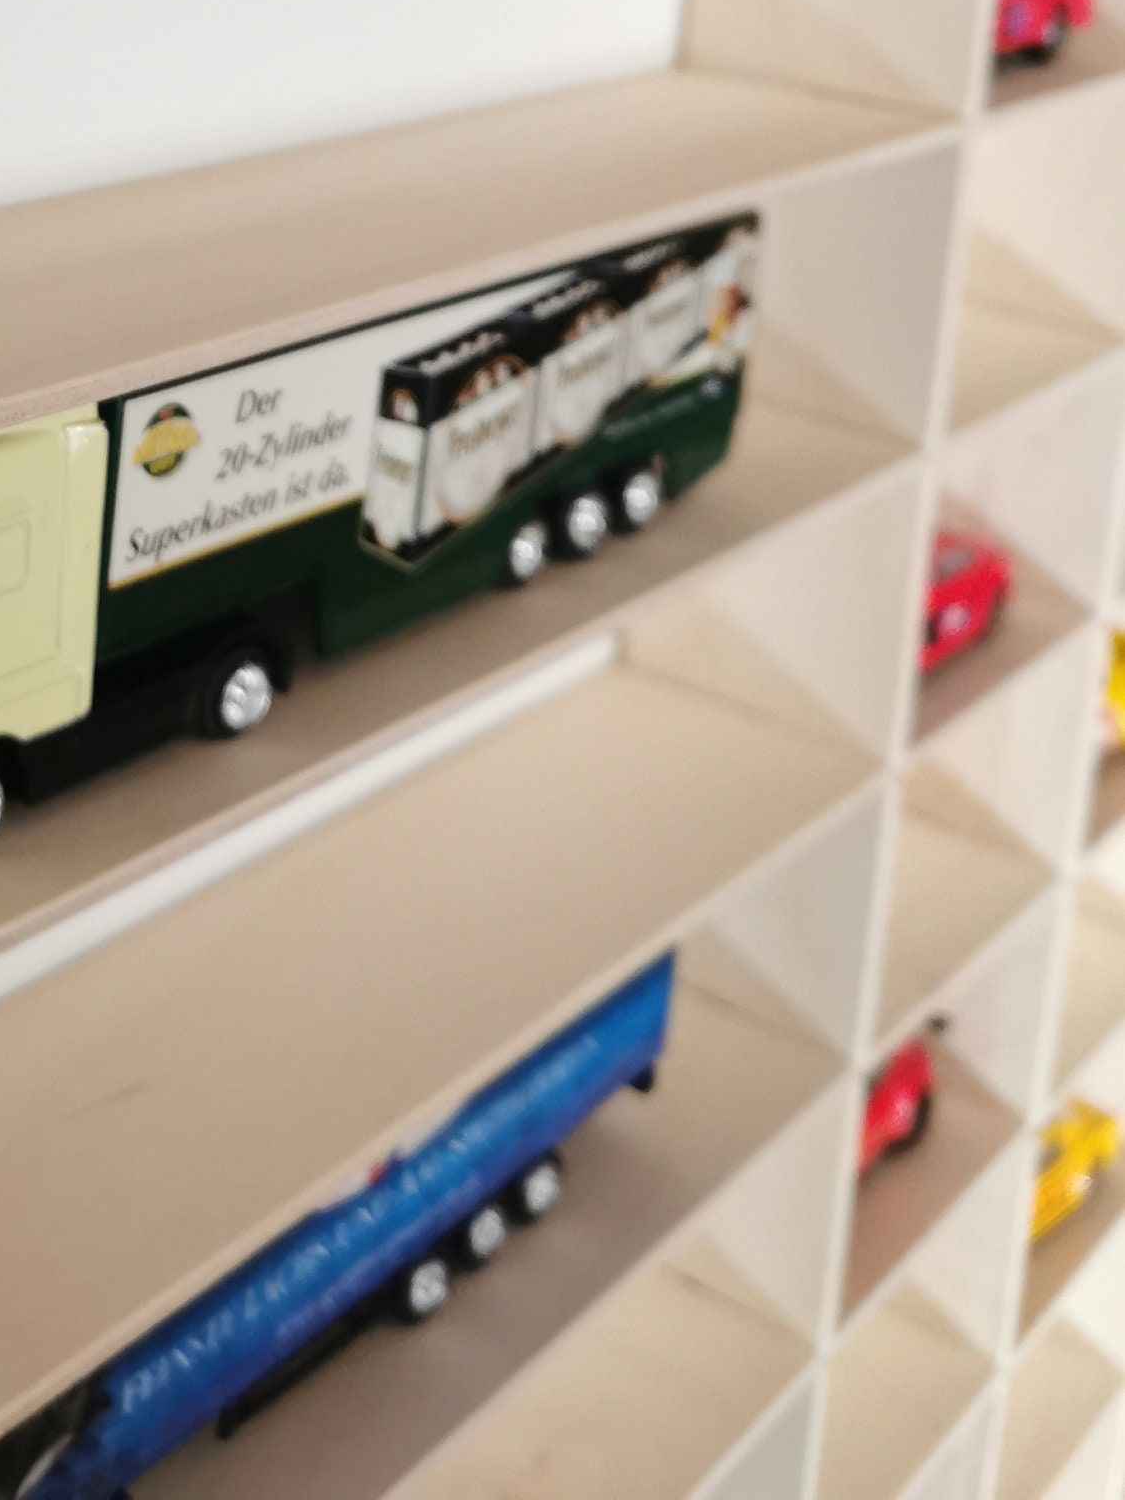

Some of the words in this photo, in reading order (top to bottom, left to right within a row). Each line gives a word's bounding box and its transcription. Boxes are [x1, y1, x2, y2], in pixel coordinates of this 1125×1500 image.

[235, 387, 283, 423] Der
[215, 410, 353, 480] 20-Zylinder
[125, 489, 277, 562] Superkasten
[285, 469, 312, 504] ist
